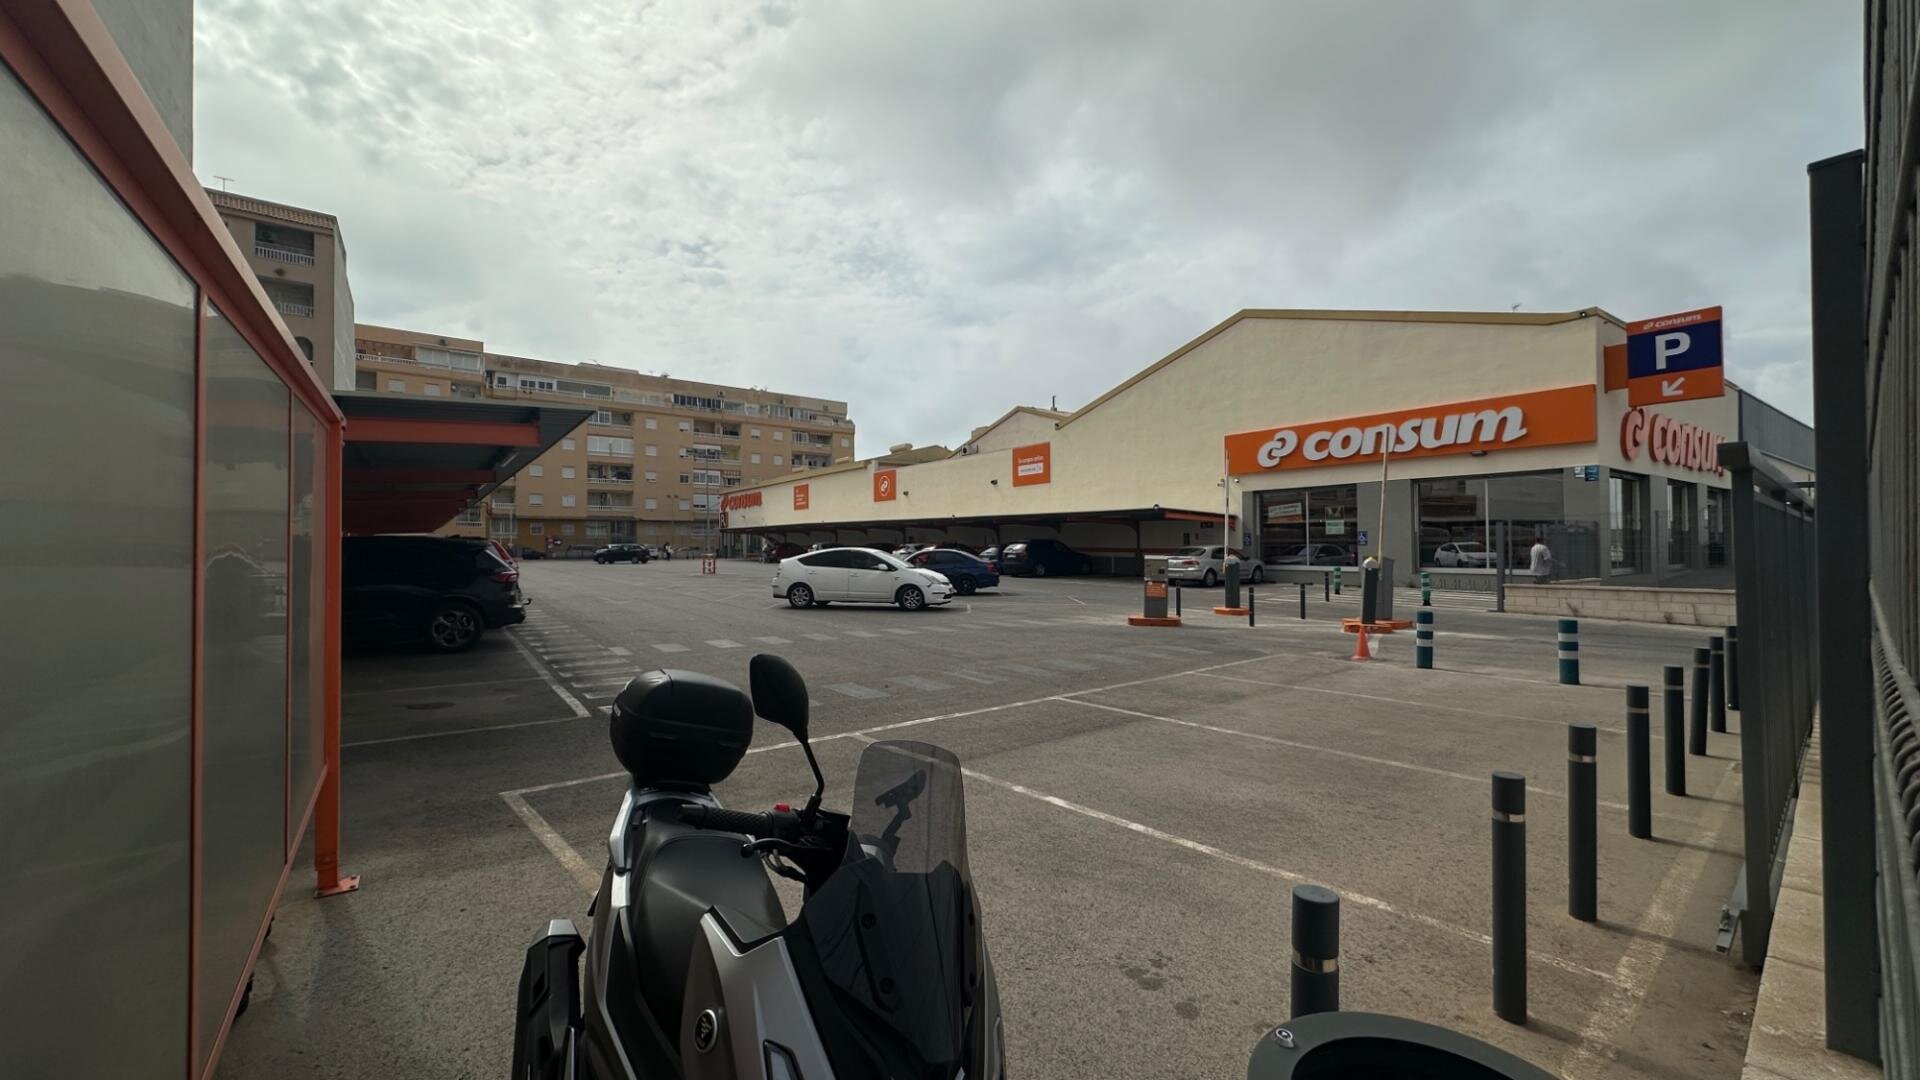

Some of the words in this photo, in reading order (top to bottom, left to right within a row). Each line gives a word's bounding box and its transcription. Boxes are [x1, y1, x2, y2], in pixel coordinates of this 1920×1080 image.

[1654, 314, 1702, 328] consum
[1655, 332, 1692, 371] P
[1302, 406, 1528, 462] consum
